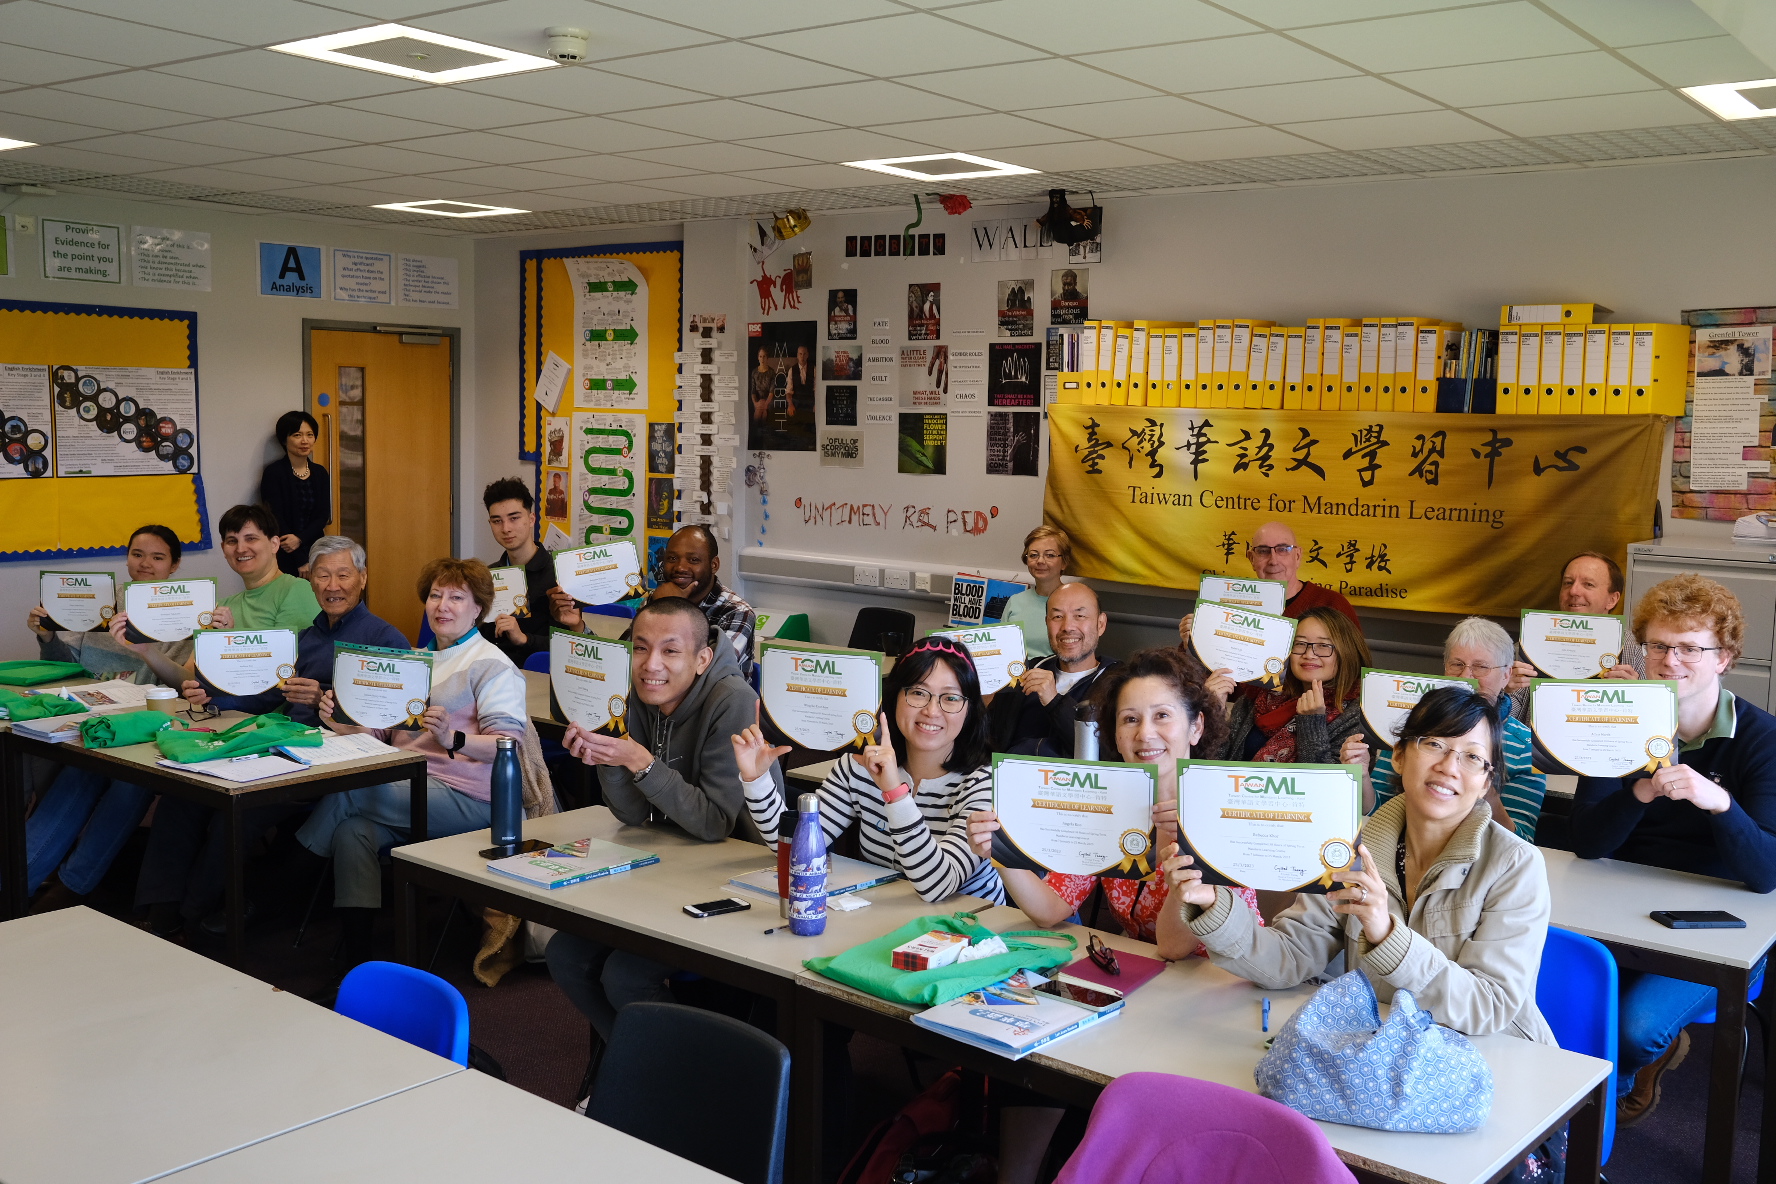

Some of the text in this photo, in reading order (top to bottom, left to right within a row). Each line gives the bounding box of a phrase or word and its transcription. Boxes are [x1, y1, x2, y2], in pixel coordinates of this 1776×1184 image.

[65, 224, 100, 236] Provide
[55, 236, 110, 250] Evidence for
[52, 250, 114, 264] the point you
[278, 246, 306, 281] A
[58, 264, 110, 277] are making.
[270, 281, 314, 295] Analysis
[748, 324, 761, 332] RSC
[774, 342, 789, 432] MACBETH
[1074, 416, 1589, 490] 臺灣華語文學習中心
[1128, 485, 1506, 529] Taiwan Centre for Mandarin Learning
[576, 548, 612, 562] TCML
[60, 578, 92, 587] TCML
[1224, 582, 1261, 594] TCML
[151, 584, 190, 596] TCML
[953, 582, 984, 599] BLOOD
[1338, 582, 1408, 604] Paradise
[953, 596, 983, 607] WILL HAVE
[952, 604, 982, 620] BLOOD
[1223, 611, 1264, 630] TCML
[1550, 618, 1594, 631] TCML
[224, 634, 268, 645] TCML
[954, 632, 996, 644] TCML
[568, 641, 603, 661] TCML
[358, 660, 401, 674] TCML
[790, 657, 842, 675] TCML
[1571, 689, 1633, 703] TCML
[1038, 769, 1107, 790] TCML
[1227, 775, 1305, 795] TCML
[1035, 800, 1070, 808] CERTIFICATE
[1224, 810, 1264, 818] CERTIFICATE
[1276, 812, 1307, 821] LEARNING
